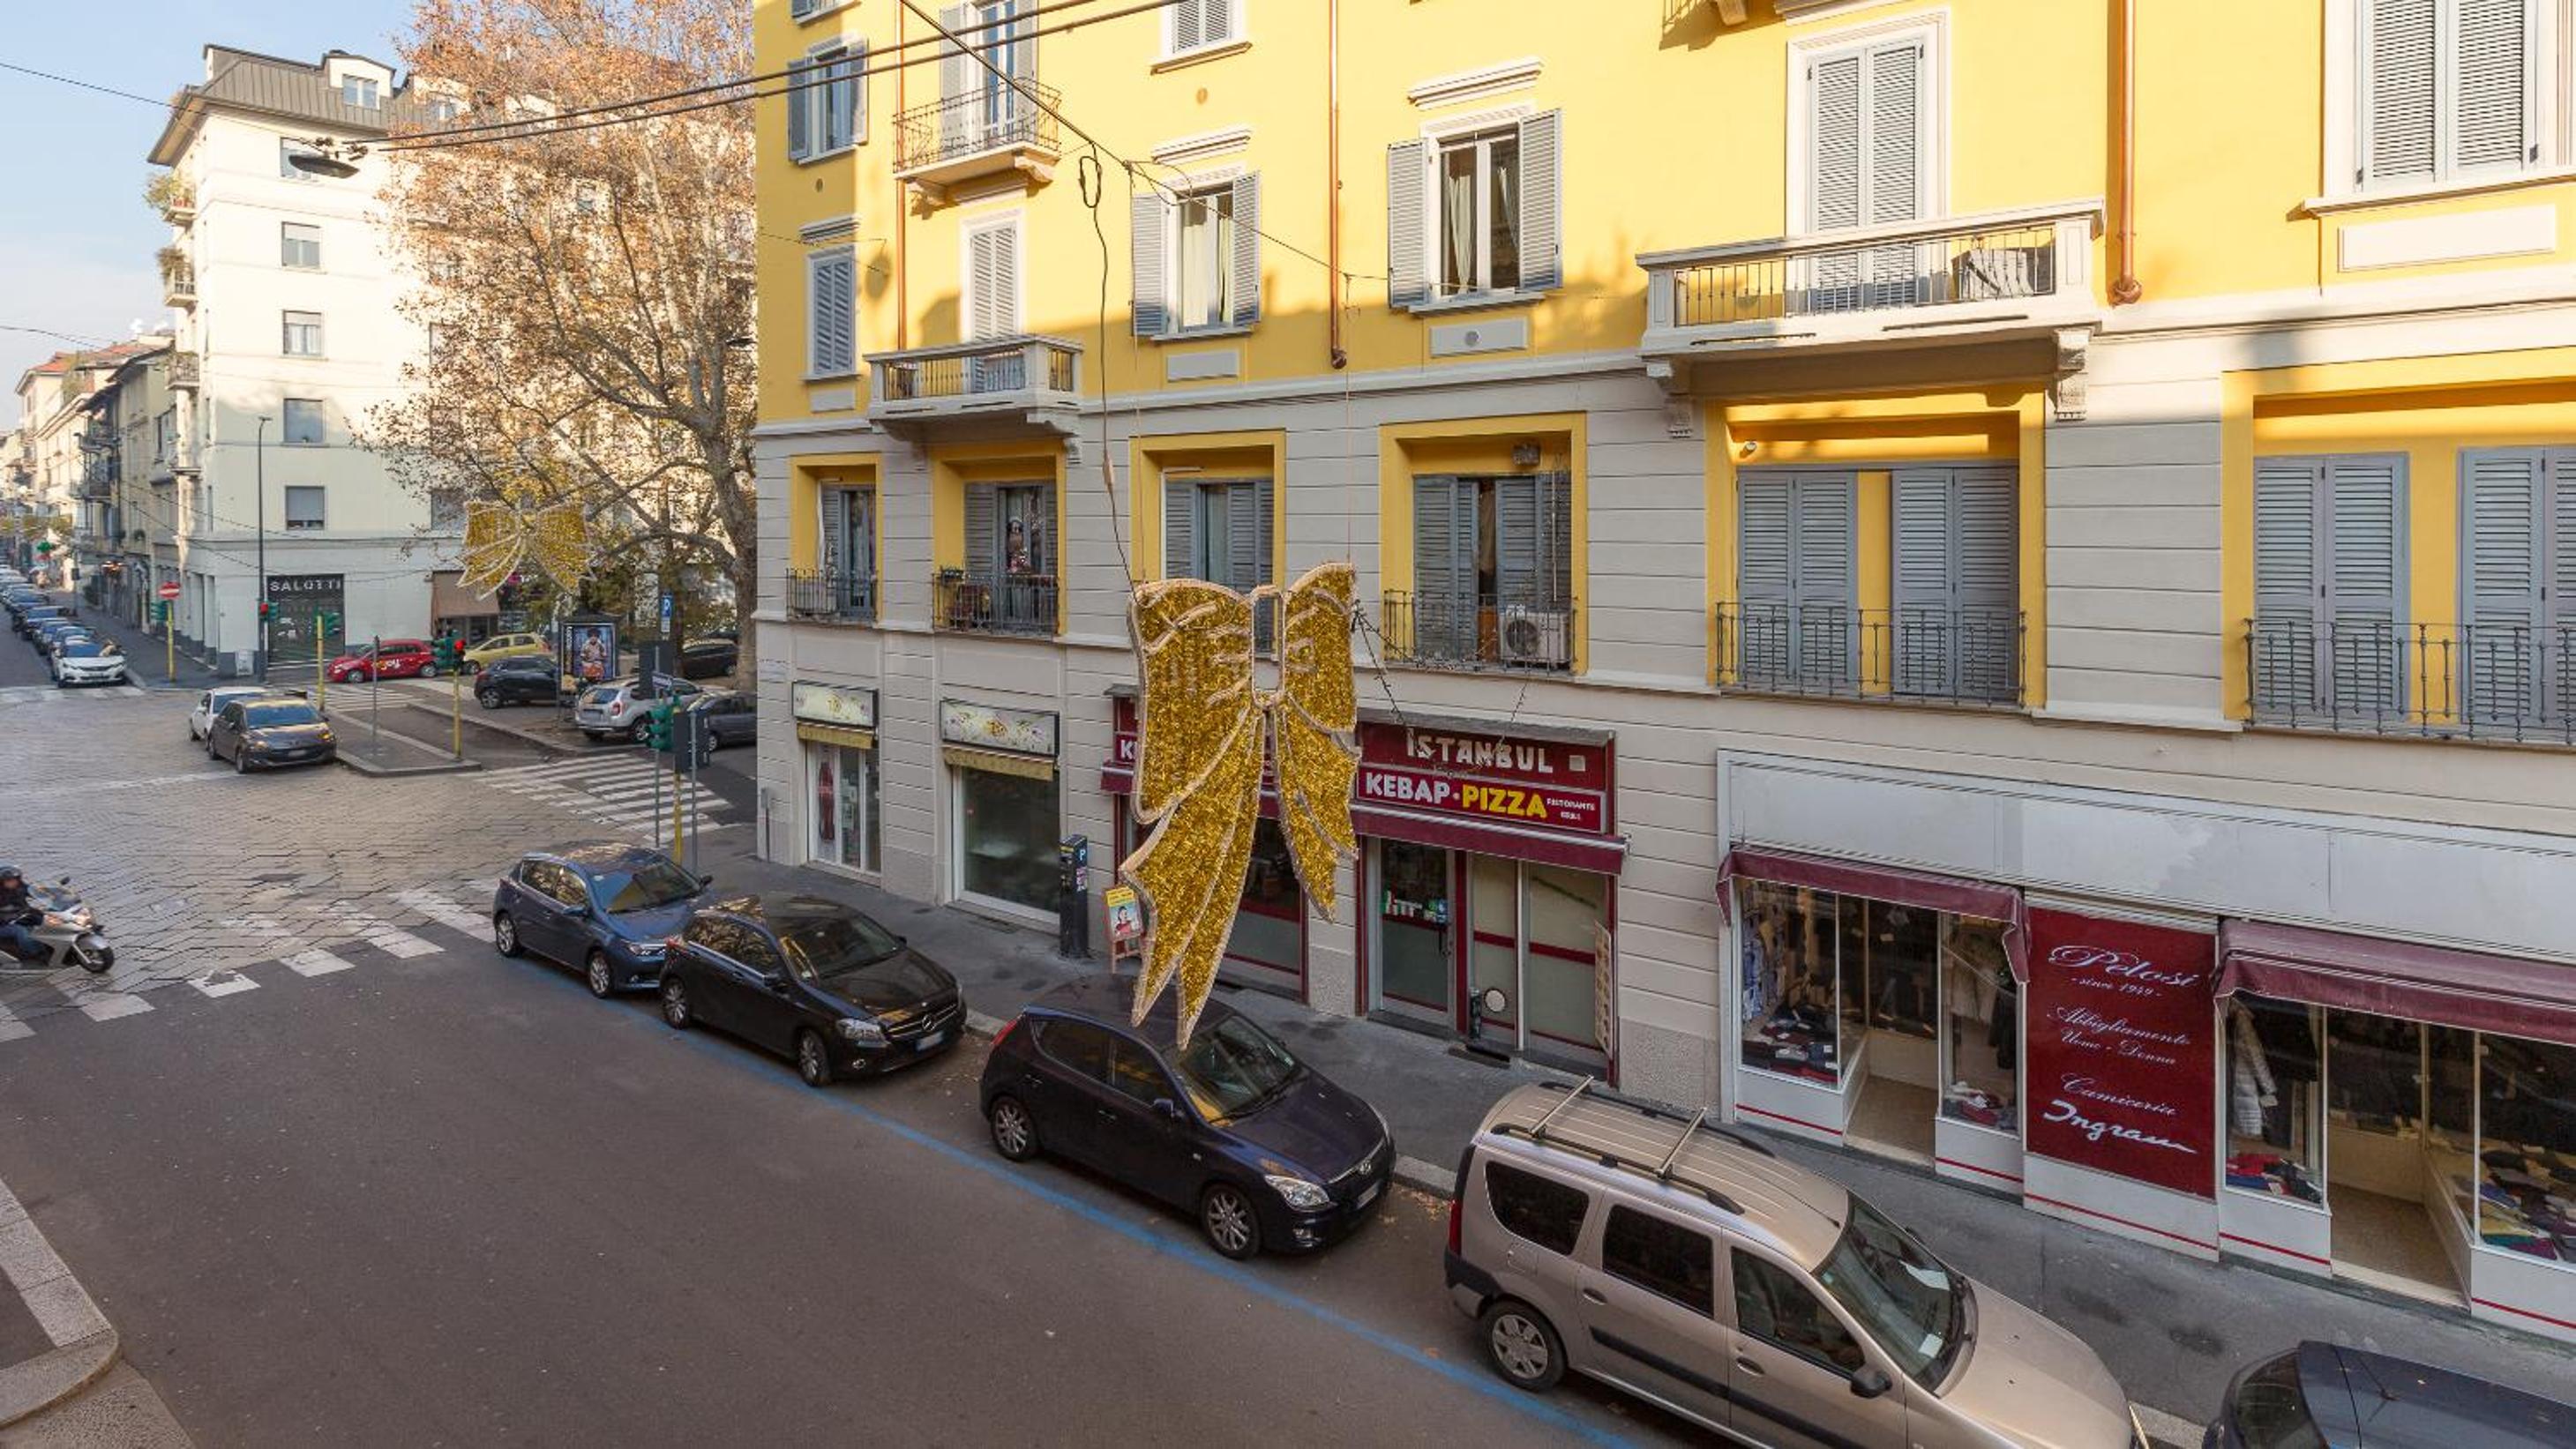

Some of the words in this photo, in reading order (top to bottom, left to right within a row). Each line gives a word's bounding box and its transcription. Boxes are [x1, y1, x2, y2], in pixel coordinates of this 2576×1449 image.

[270, 579, 341, 591] SALOTTI
[1366, 772, 1450, 804] KEBAP
[1462, 783, 1547, 818] PIZZA
[1079, 849, 1086, 861] P
